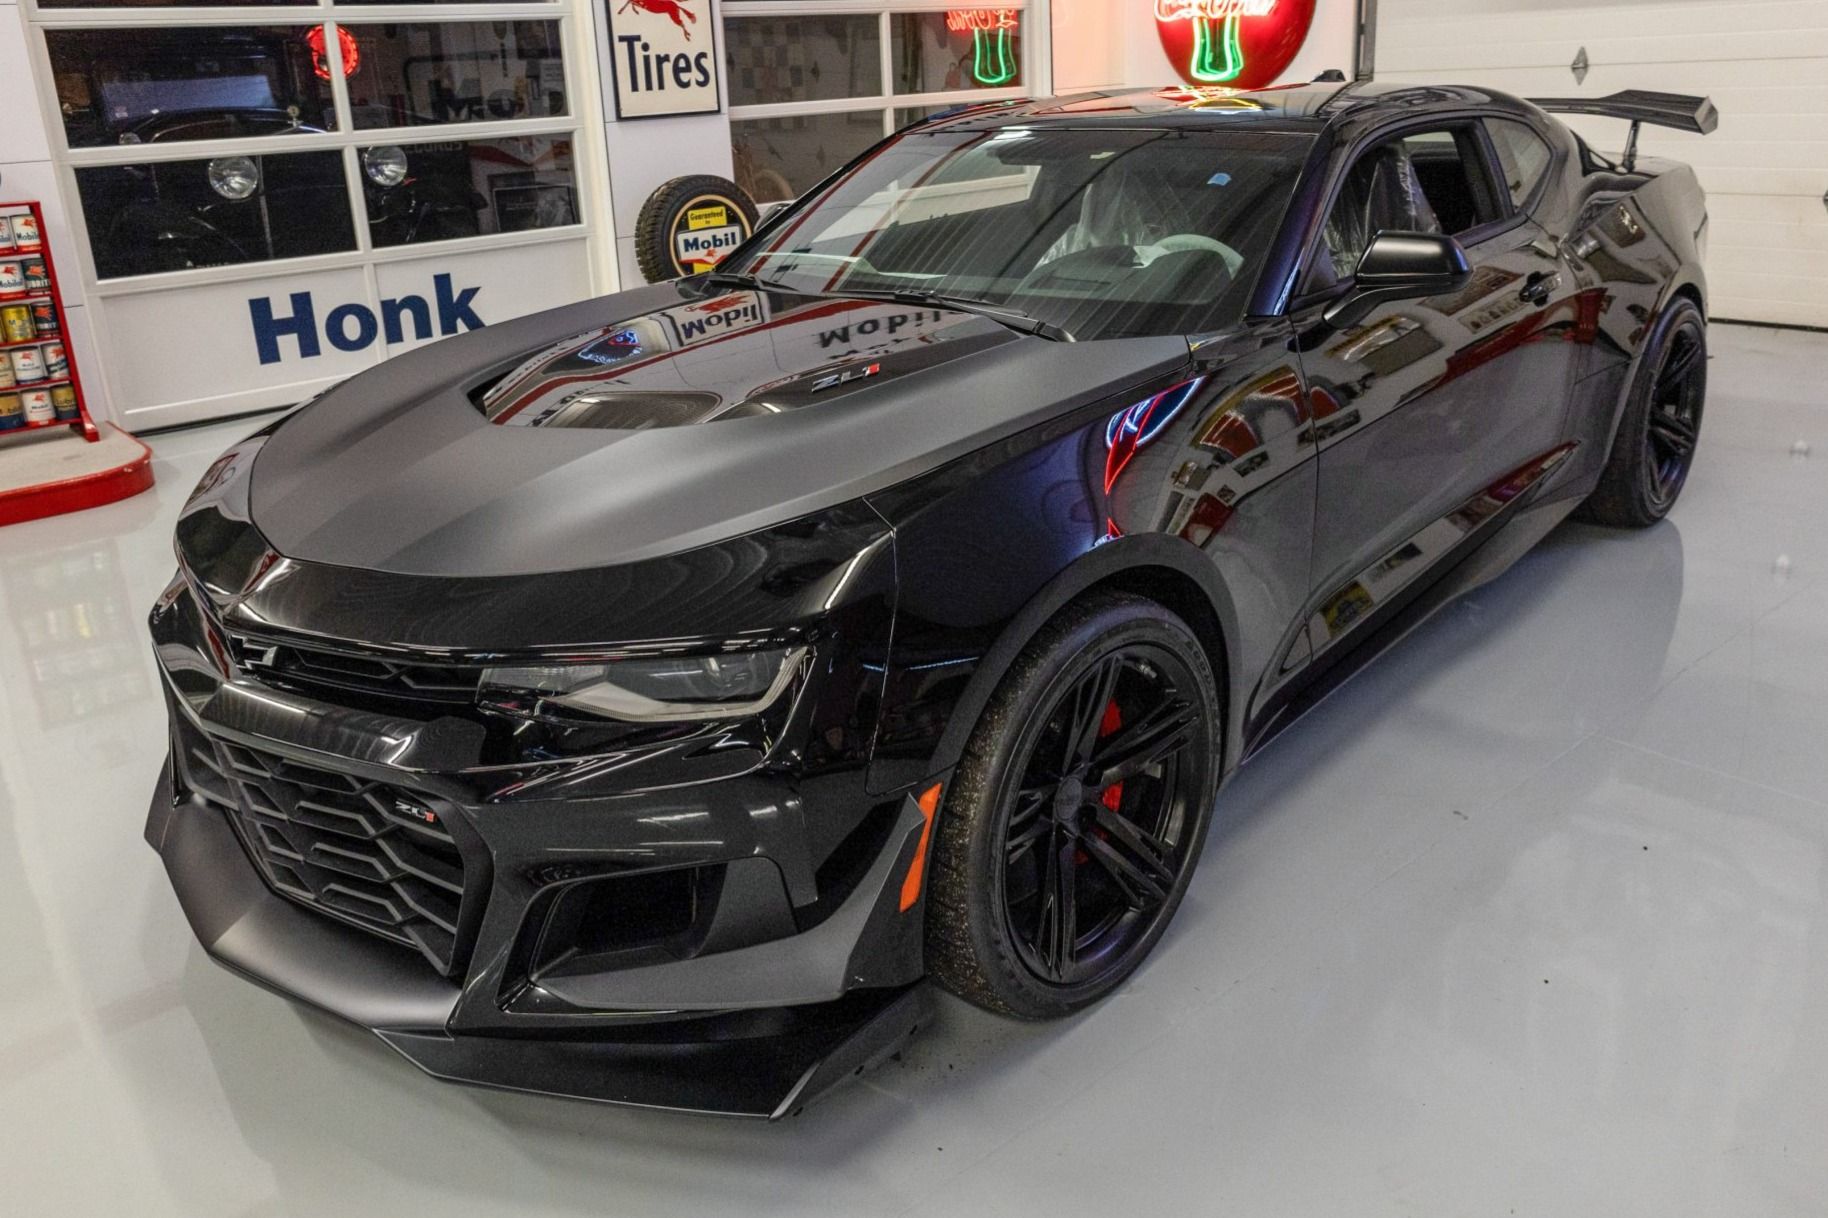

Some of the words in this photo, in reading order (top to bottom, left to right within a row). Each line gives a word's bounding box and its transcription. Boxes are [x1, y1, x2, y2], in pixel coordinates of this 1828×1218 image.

[617, 35, 710, 92] Tires
[684, 232, 736, 252] Mobil
[248, 273, 486, 366] Honk
[811, 362, 881, 392] ZL1
[396, 801, 435, 822] ZL1
